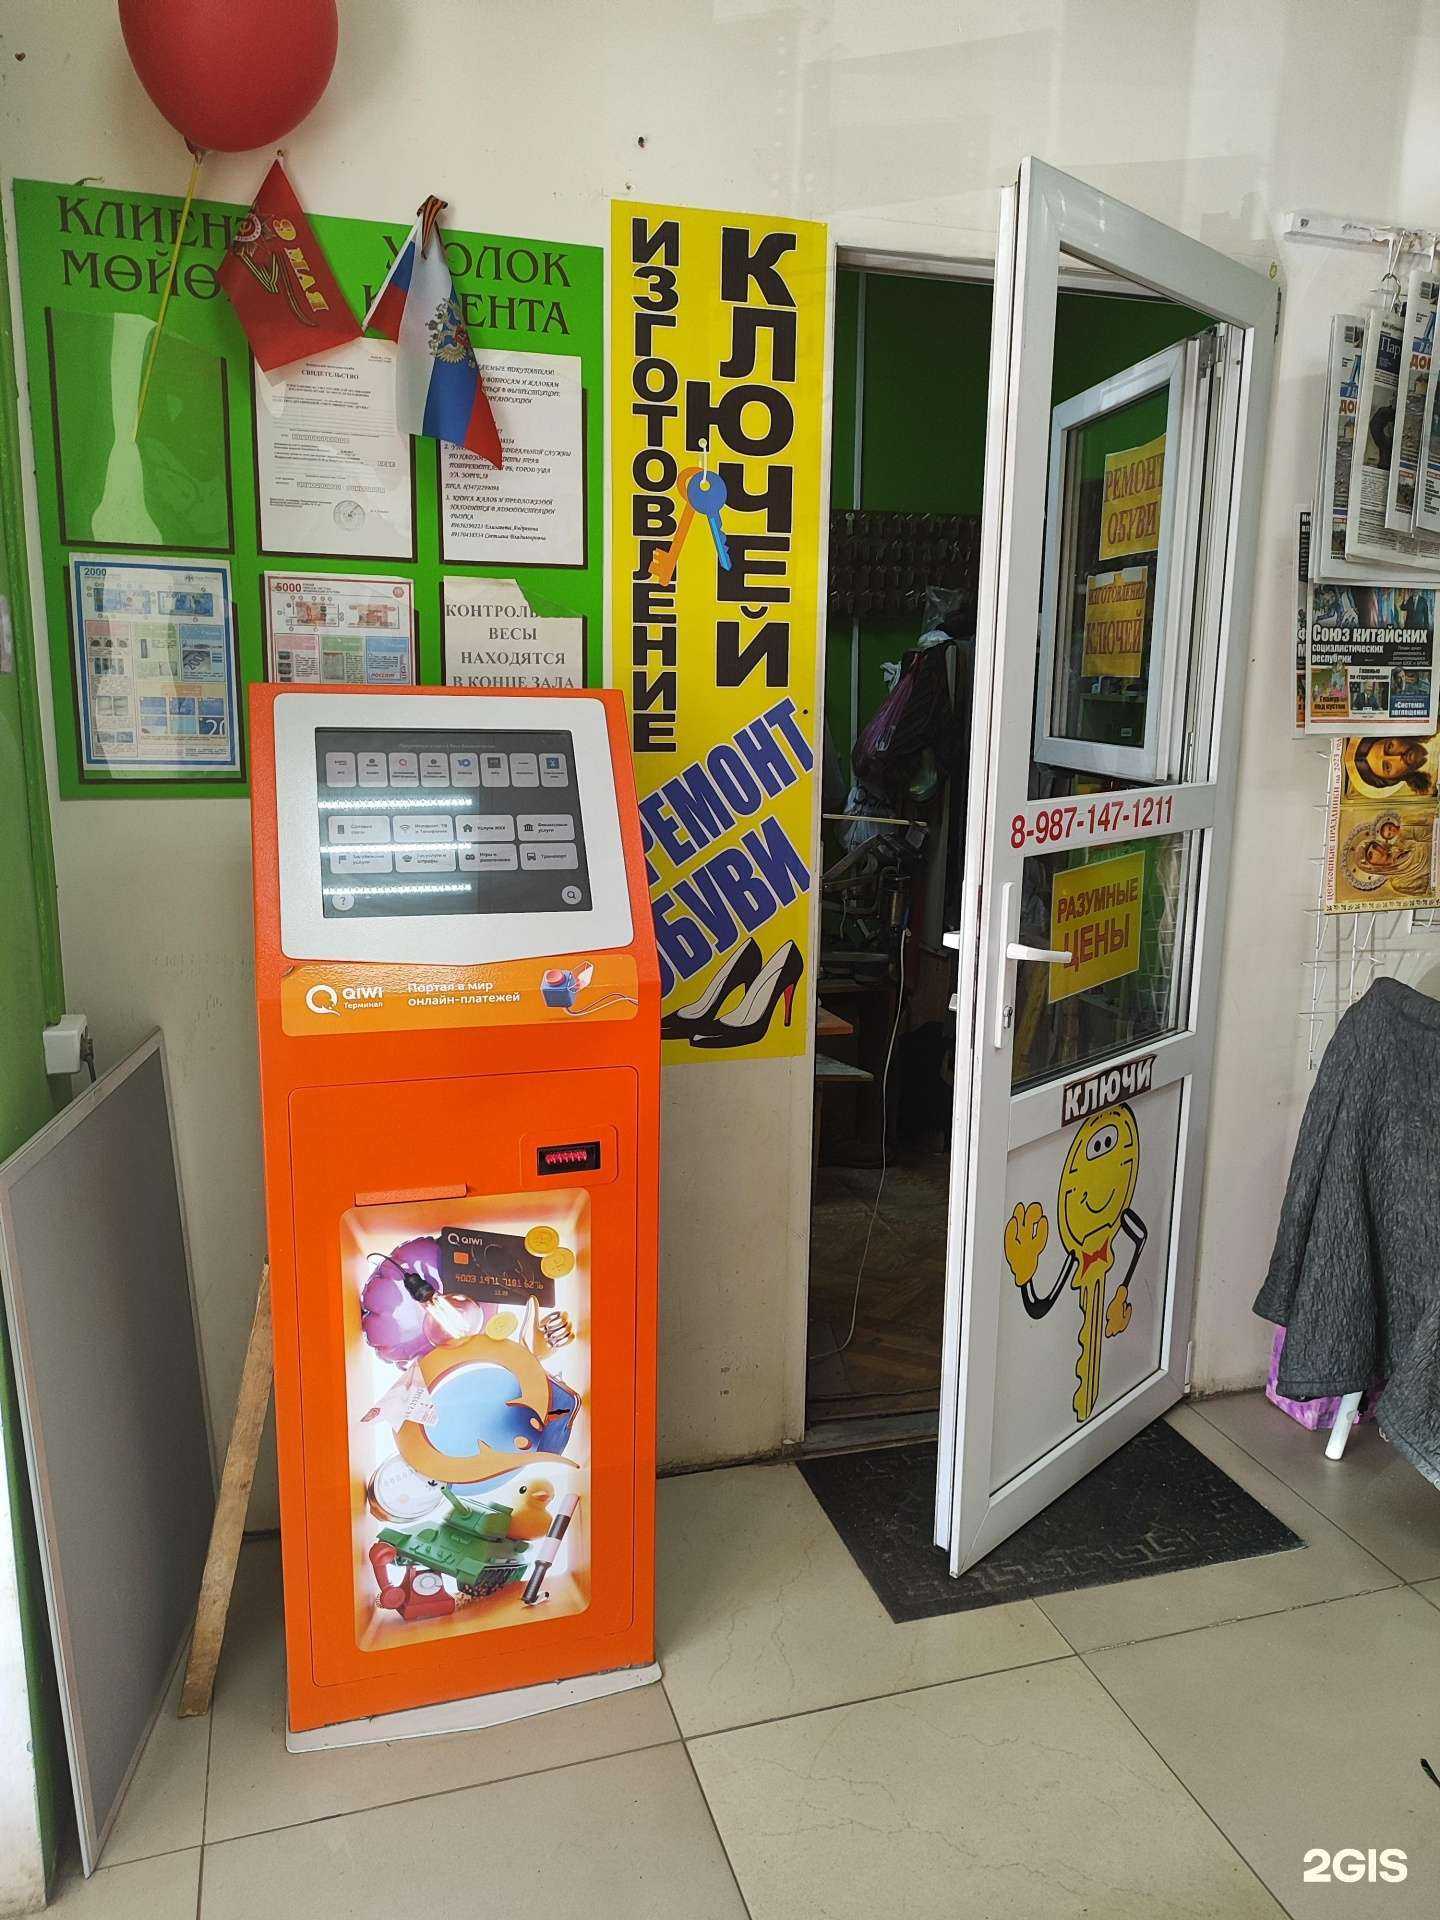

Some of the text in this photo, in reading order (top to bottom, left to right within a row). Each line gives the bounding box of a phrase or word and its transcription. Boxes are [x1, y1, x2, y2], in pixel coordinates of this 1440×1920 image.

[685, 225, 798, 688] КЛЮЧЕЙ
[631, 216, 680, 753] ИЗГОТОВЛЕНИЕ
[1107, 501, 1158, 545] ОБУВИ
[83, 567, 107, 577] 2000
[275, 582, 302, 593] 5000
[488, 627, 537, 641] ВЕСЫ
[1085, 612, 1144, 655] КЛЮЧЕЙ
[1312, 624, 1428, 643] Союз китайских
[1312, 643, 1384, 654] социалистических
[461, 651, 566, 667] НАХОДЯТСЯ
[452, 676, 463, 687] В
[531, 677, 575, 690] ЗАЛА
[1010, 795, 1174, 849] 8-987-147-1211
[1329, 785, 1341, 843] ПРАЗДНИКИ
[1326, 844, 1336, 902] ЦЕРКОВНЫЕ
[651, 815, 812, 1001] БУВИ
[1056, 877, 1138, 924] РАЗУМНЫЕ
[1062, 913, 1131, 972] ЦЕНЫ
[344, 1000, 383, 1009] Терминал
[408, 982, 453, 995] Портал
[467, 981, 494, 992] мир
[408, 991, 521, 1007] онлайн-платежей
[1063, 1055, 1155, 1121] КЛЮЧИ
